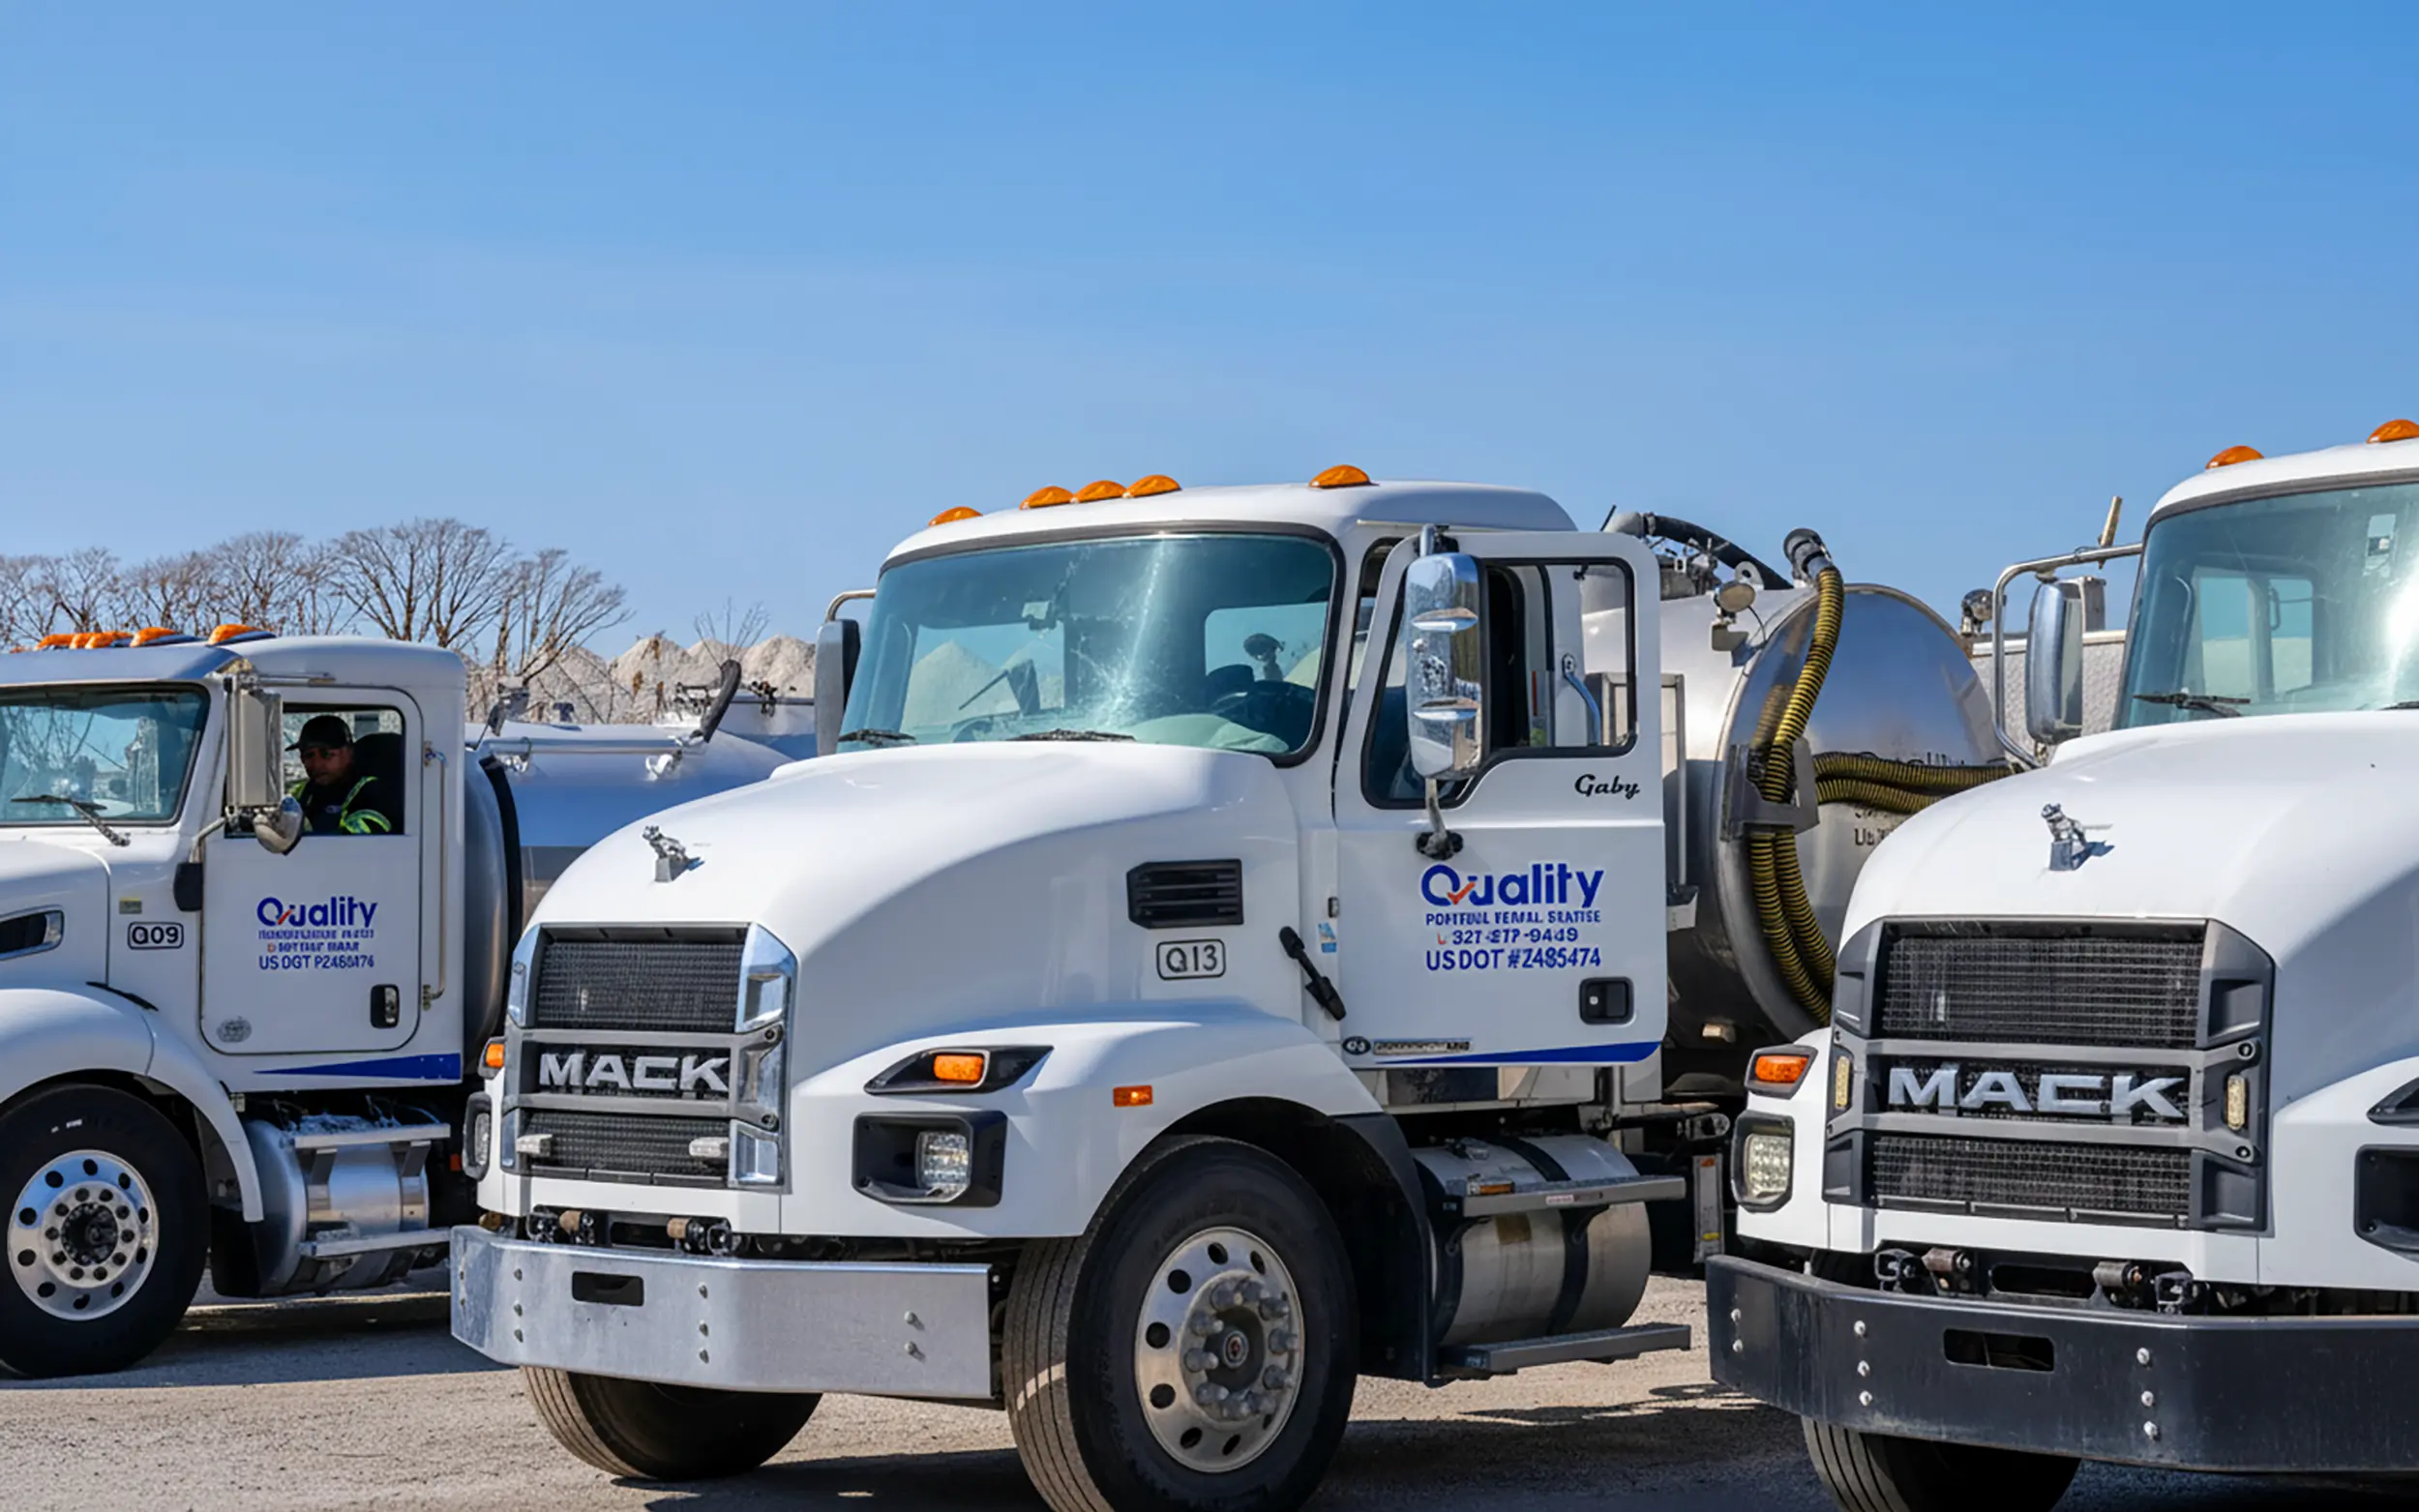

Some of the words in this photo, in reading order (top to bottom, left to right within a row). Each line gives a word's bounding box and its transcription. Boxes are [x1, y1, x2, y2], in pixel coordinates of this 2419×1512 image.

[1574, 773, 1641, 800] Gaby
[1420, 863, 1605, 909] Quality
[256, 896, 378, 928] Quality
[132, 926, 179, 945] Q09
[1166, 944, 1218, 973] Q13
[539, 1052, 730, 1092] MACK
[1888, 1066, 2186, 1118] MACK
